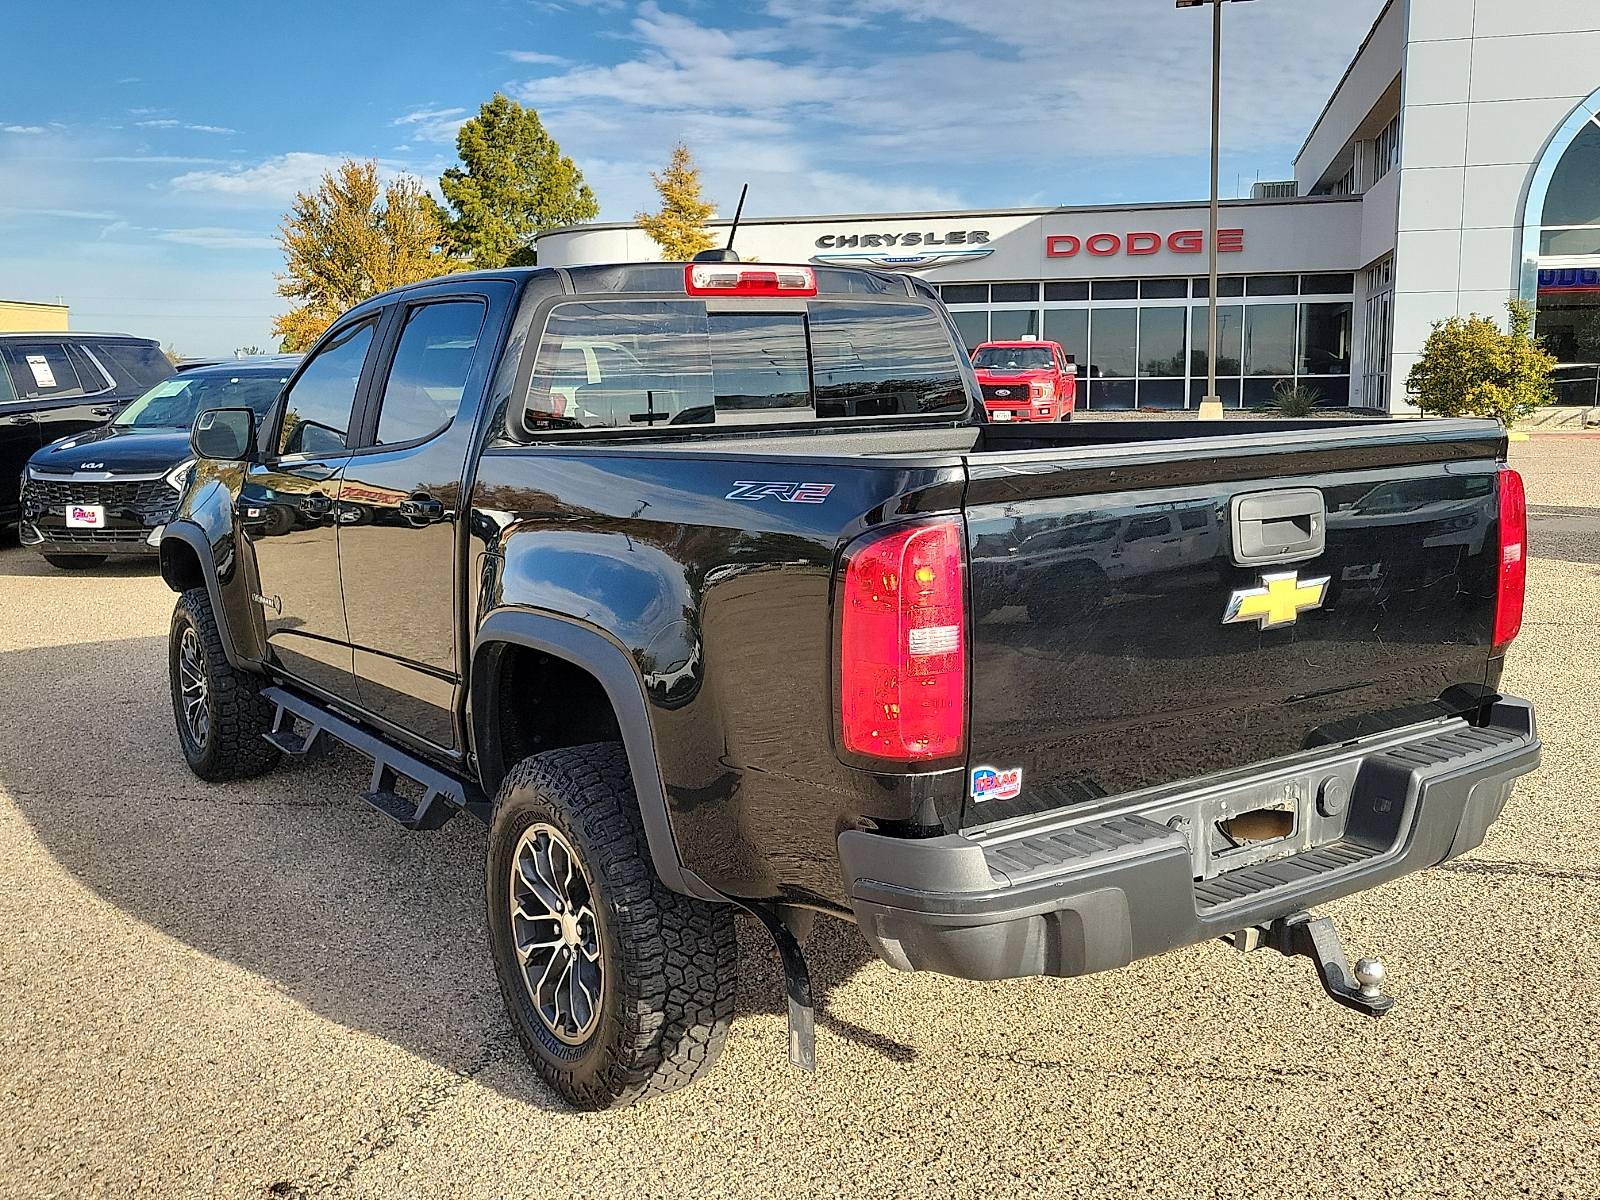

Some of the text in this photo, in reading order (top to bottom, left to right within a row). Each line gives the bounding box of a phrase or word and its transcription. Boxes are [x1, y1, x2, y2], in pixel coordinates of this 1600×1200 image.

[815, 231, 990, 249] CHRYSLER
[1046, 228, 1244, 258] DODGE
[724, 480, 836, 503] ZR2
[974, 772, 1018, 792] TEXAS
